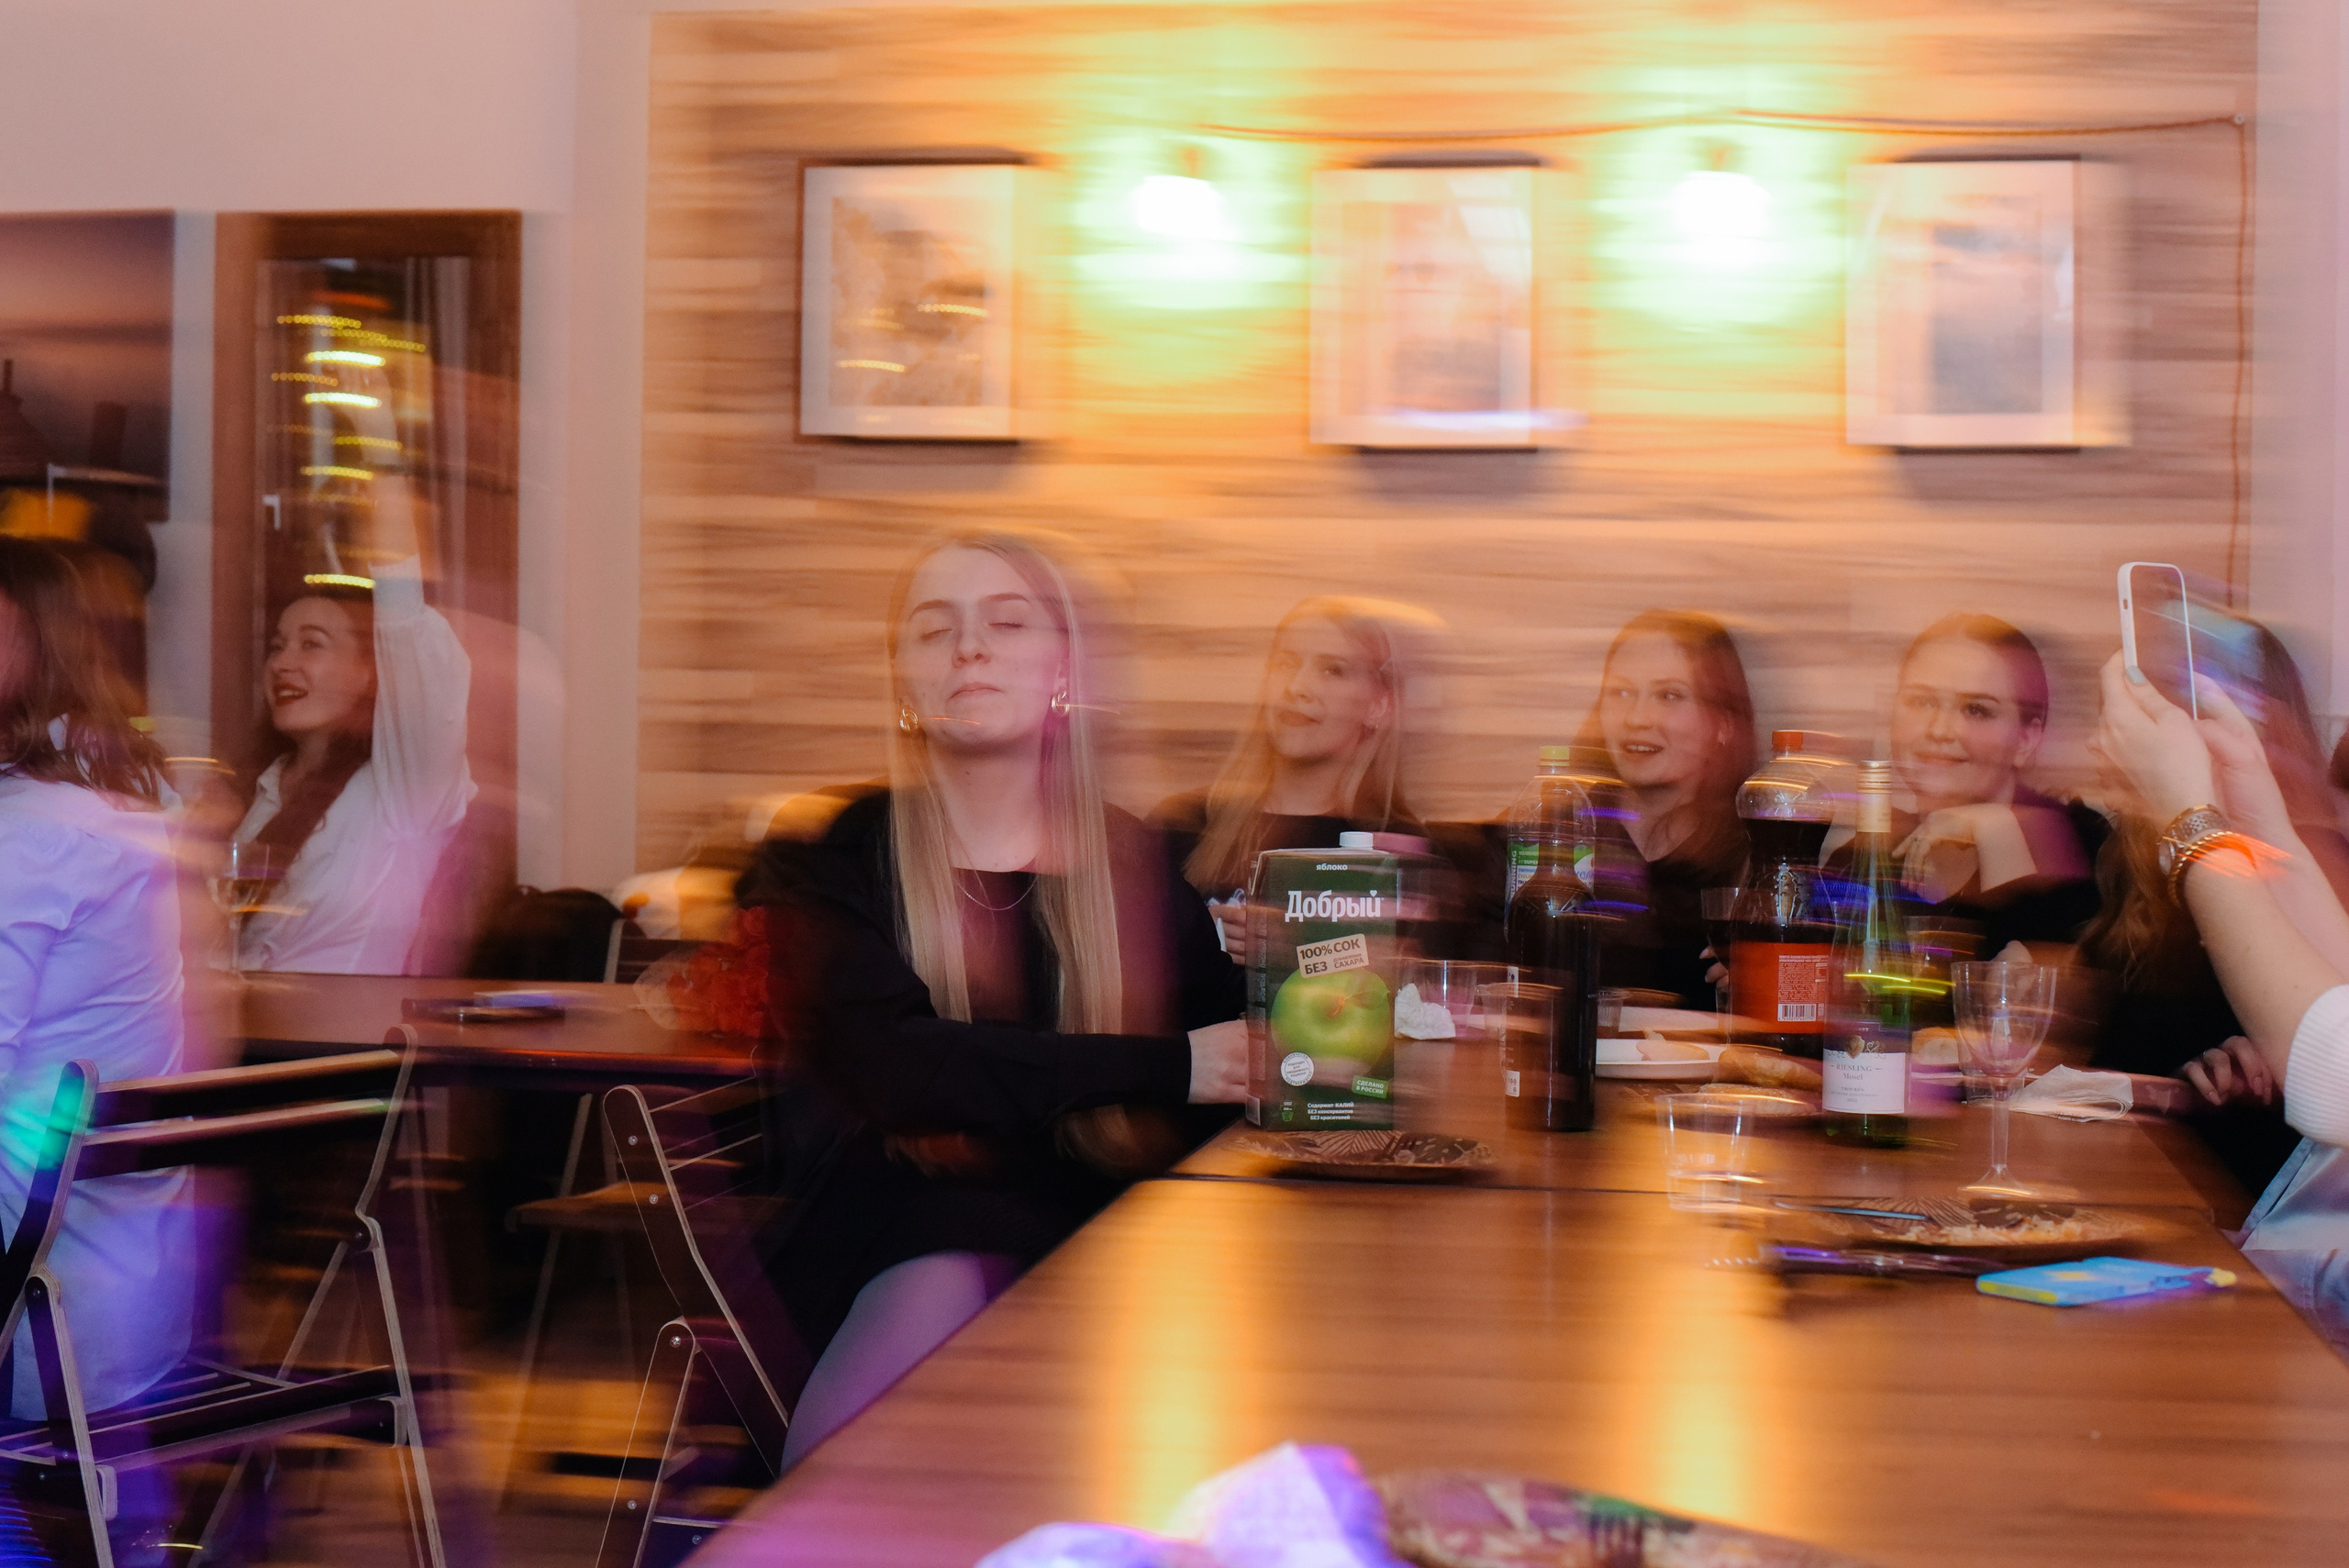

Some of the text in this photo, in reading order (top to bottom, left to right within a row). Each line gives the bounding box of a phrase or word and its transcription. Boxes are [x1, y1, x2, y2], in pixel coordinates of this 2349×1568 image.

[1285, 889, 1382, 923] Добрый
[1299, 938, 1361, 960] 100% СОК
[1304, 961, 1328, 975] БЕЗ
[1334, 957, 1364, 969] САХАРА
[1843, 1073, 1864, 1081] Mosel
[1357, 1079, 1385, 1088] СДЕЛАНО
[1361, 1086, 1384, 1095] РОССИИ
